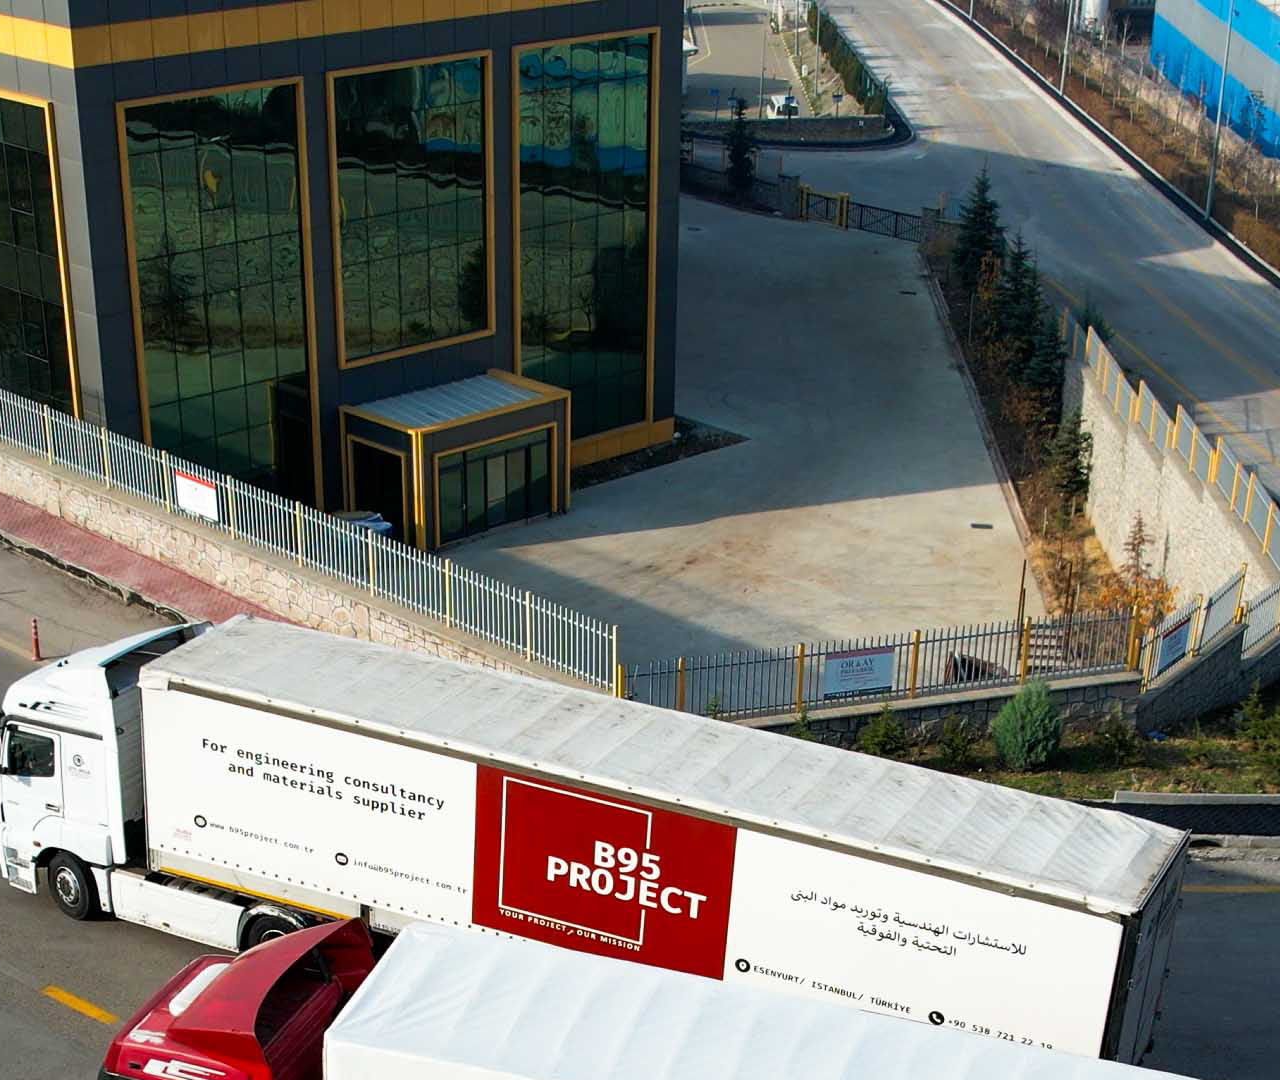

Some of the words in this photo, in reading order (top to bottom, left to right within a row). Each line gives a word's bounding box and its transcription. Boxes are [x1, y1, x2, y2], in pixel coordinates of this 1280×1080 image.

[202, 738, 227, 753] For
[237, 748, 334, 783] engineering
[344, 775, 445, 810] consultancy
[228, 762, 254, 777] and
[263, 771, 343, 800] materials
[353, 793, 426, 821] supplier
[593, 840, 661, 880] B95
[546, 855, 708, 919] PROJECT
[790, 890, 817, 903] البنى
[820, 896, 847, 911] مواد
[850, 905, 888, 922] وتوريد
[499, 908, 524, 921] YOUR
[527, 916, 567, 931] PROJECT
[576, 929, 597, 940] OUR
[600, 935, 641, 952] MISSION
[857, 921, 907, 947] والفوقية
[893, 911, 949, 936] الهندسية
[912, 936, 957, 957] التحتية
[953, 930, 1027, 956] للاستشارات
[870, 996, 911, 1014] TÜRKİYE
[972, 1024, 990, 1036] 538
[996, 1030, 1015, 1042] 721
